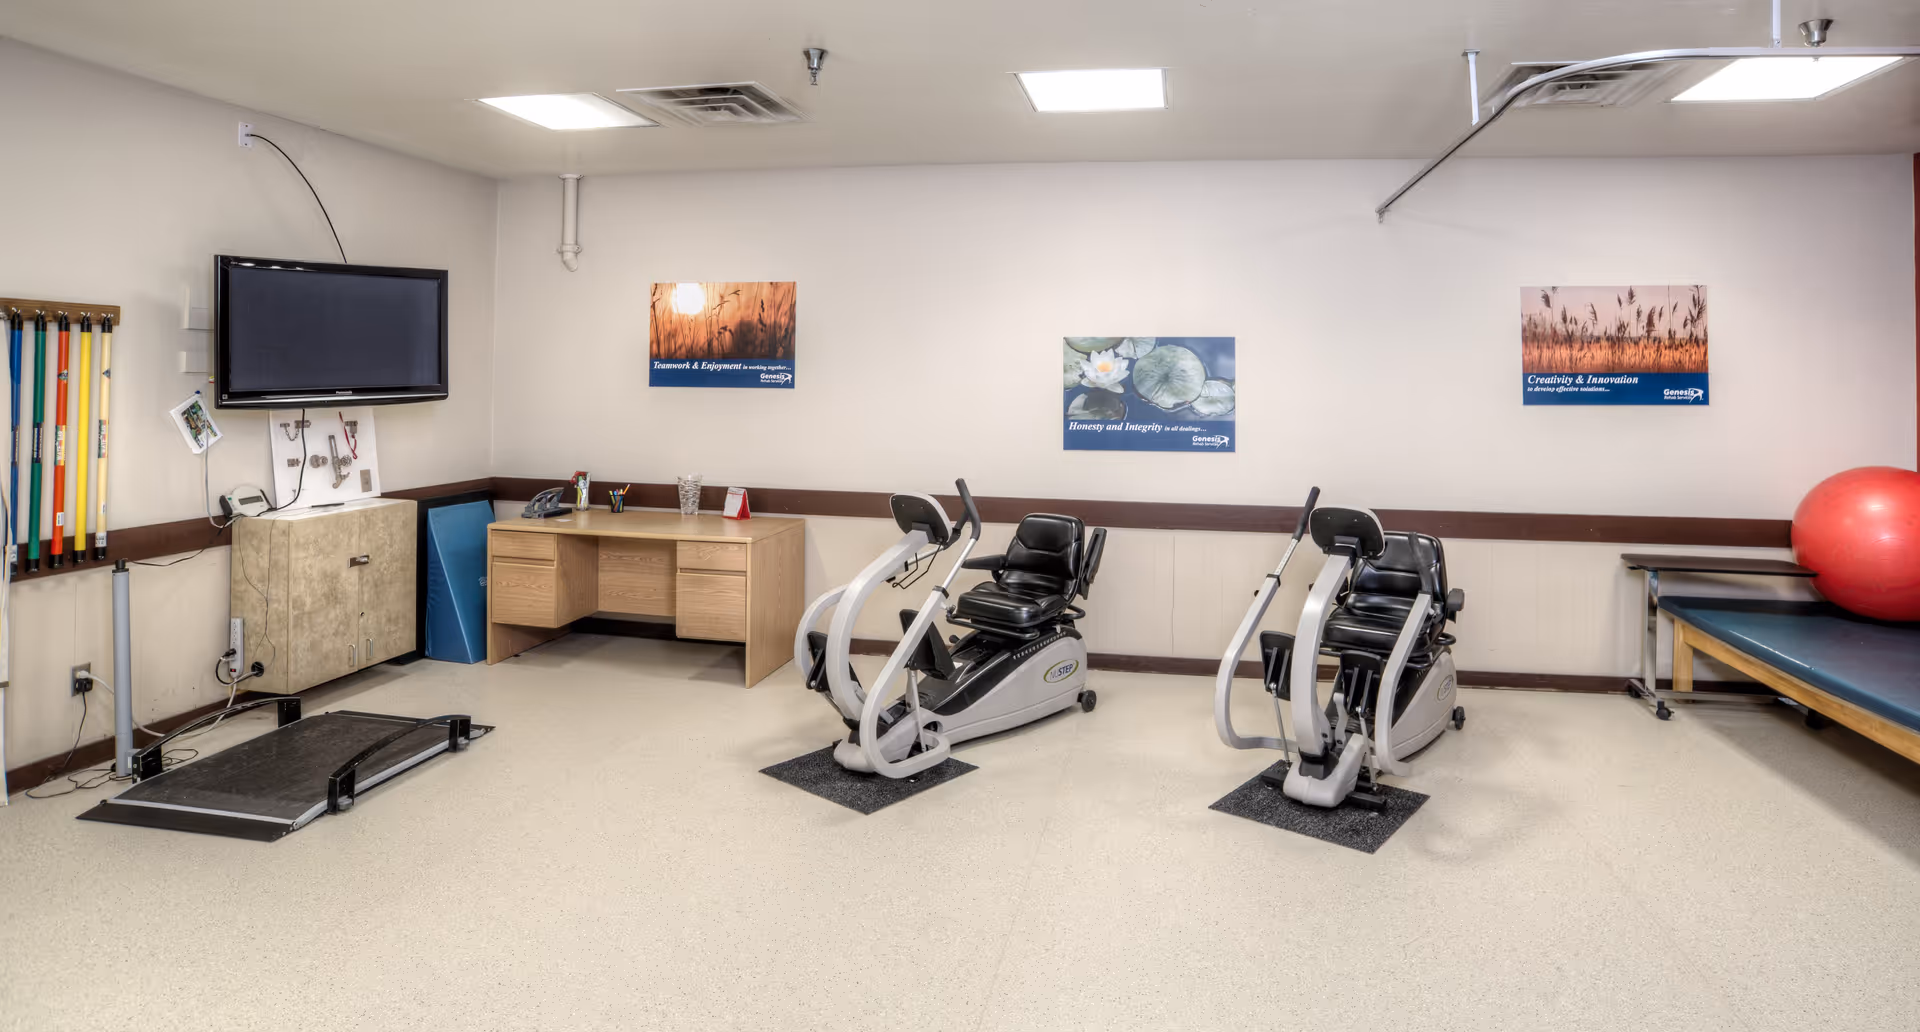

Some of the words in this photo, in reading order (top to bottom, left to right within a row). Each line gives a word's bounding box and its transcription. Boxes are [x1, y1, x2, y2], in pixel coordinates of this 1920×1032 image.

[653, 361, 690, 369] Teamwork
[692, 361, 699, 369] &
[701, 362, 742, 371] Enjoyment
[1527, 375, 1574, 386] Creativity
[1575, 375, 1584, 384] &
[1586, 375, 1639, 384] Innovation
[1663, 388, 1694, 396] Genesis
[1069, 422, 1103, 432] Honesty
[1106, 422, 1123, 431] and
[1125, 422, 1162, 433] Integrity
